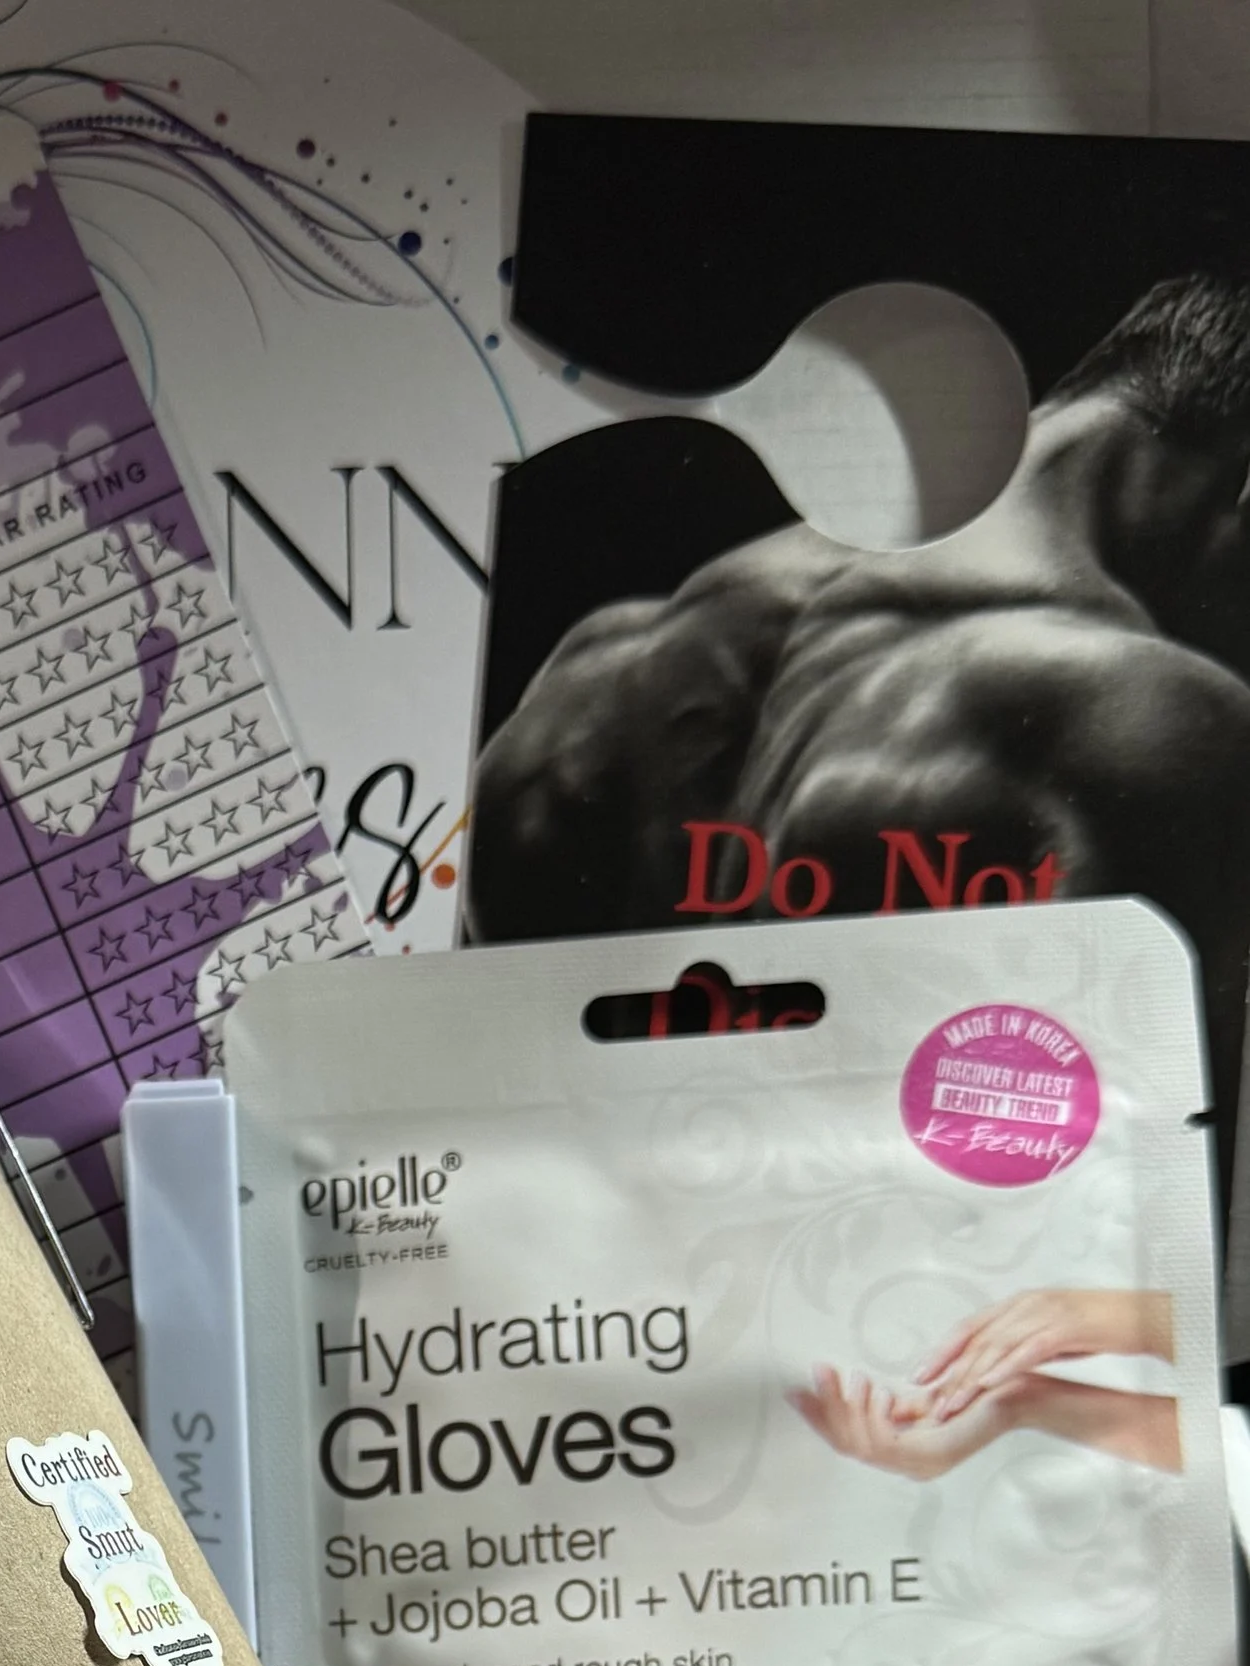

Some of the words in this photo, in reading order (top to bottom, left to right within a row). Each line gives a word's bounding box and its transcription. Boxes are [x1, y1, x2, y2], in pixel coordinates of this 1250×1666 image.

[34, 461, 148, 522] RATING
[674, 820, 833, 919] Do
[875, 830, 1067, 917] Not
[943, 1014, 995, 1048] MADE
[1002, 1014, 1021, 1036] IN
[1025, 1020, 1081, 1067] KOREA
[936, 1058, 1013, 1090] DISCOVER
[1017, 1071, 1074, 1097] LATEST
[940, 1087, 1001, 1117] BEAUTY
[1008, 1096, 1061, 1122] TREND
[304, 1244, 450, 1273] CRUELTY-FREE
[316, 1298, 689, 1398] Hydrating
[21, 1444, 122, 1488] Certified
[318, 1403, 676, 1500] Gloves
[78, 1525, 144, 1560] Smut
[324, 1534, 449, 1579] Shea
[465, 1522, 617, 1568] butter
[115, 1600, 183, 1637] Lover
[370, 1586, 539, 1642] Jojoba
[556, 1577, 620, 1622] Oil
[678, 1562, 872, 1613] Vitamin
[891, 1557, 922, 1603] E
